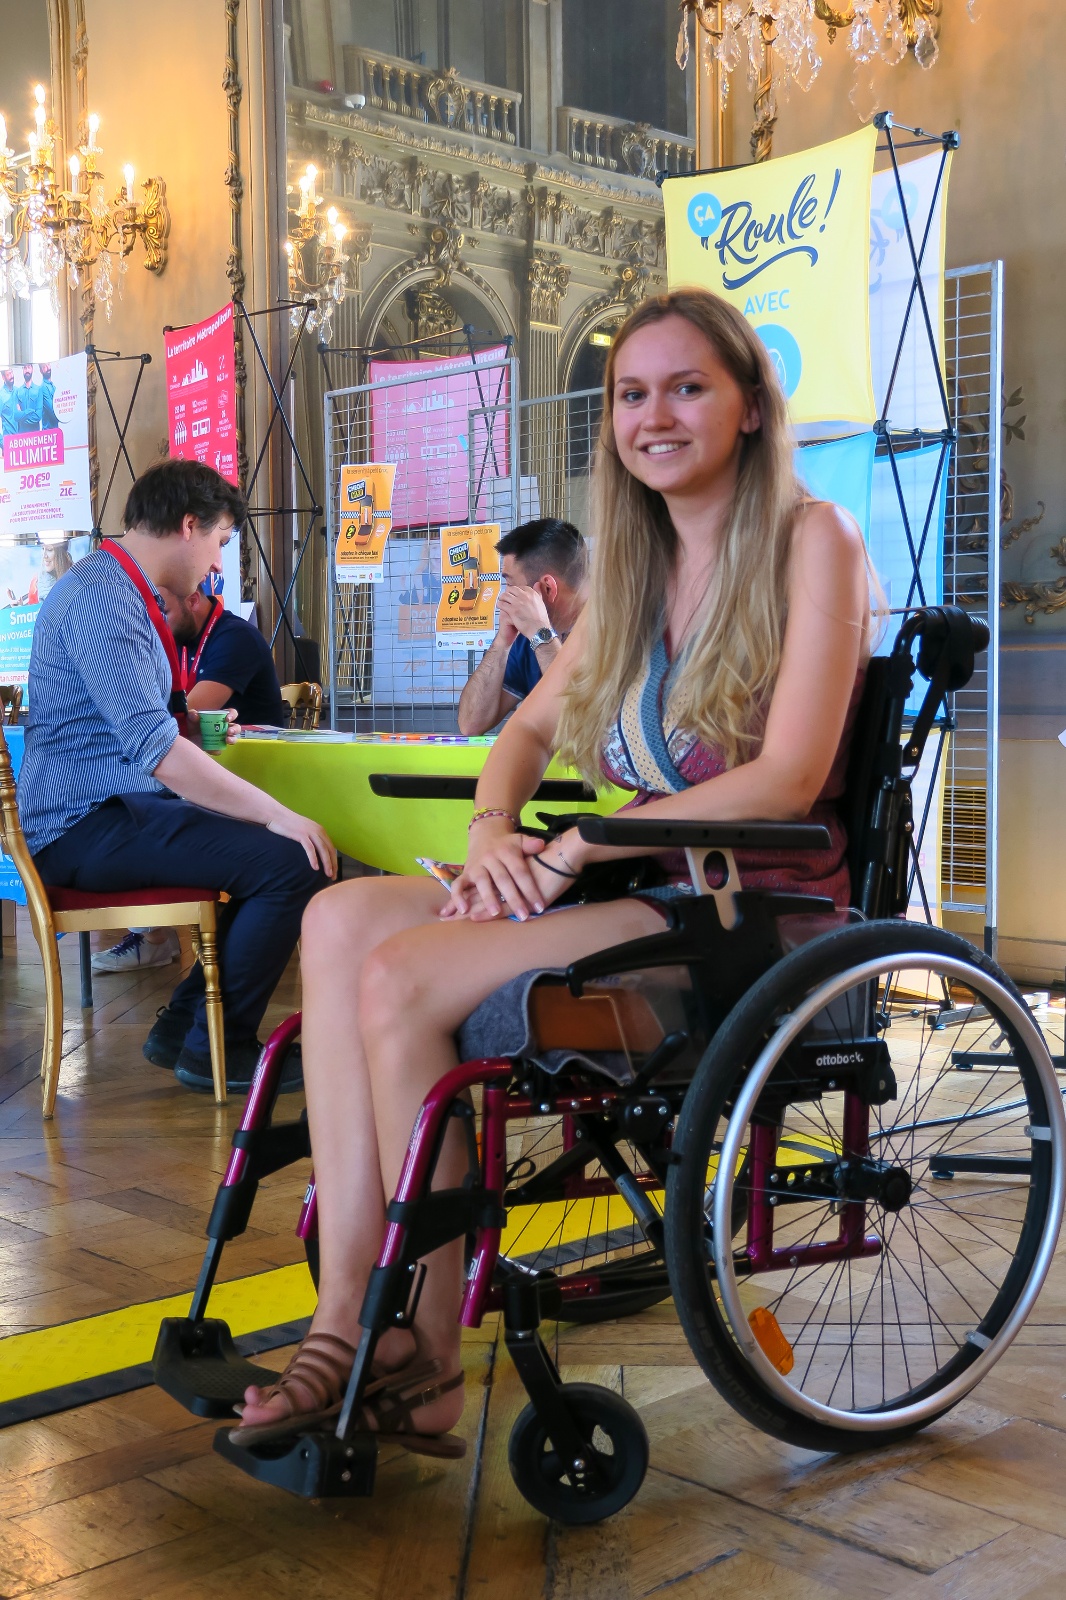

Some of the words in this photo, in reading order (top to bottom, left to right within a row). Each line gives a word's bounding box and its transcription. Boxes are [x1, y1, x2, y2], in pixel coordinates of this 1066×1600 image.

[694, 204, 715, 228] ÇA
[744, 288, 790, 317] AVEC
[173, 336, 195, 356] territoire
[196, 308, 232, 344] Métropolitain
[9, 433, 58, 449] ABONNEMENT
[10, 442, 58, 467] ILLIMITÉ
[59, 487, 73, 497] 21€
[9, 610, 40, 626] Smar
